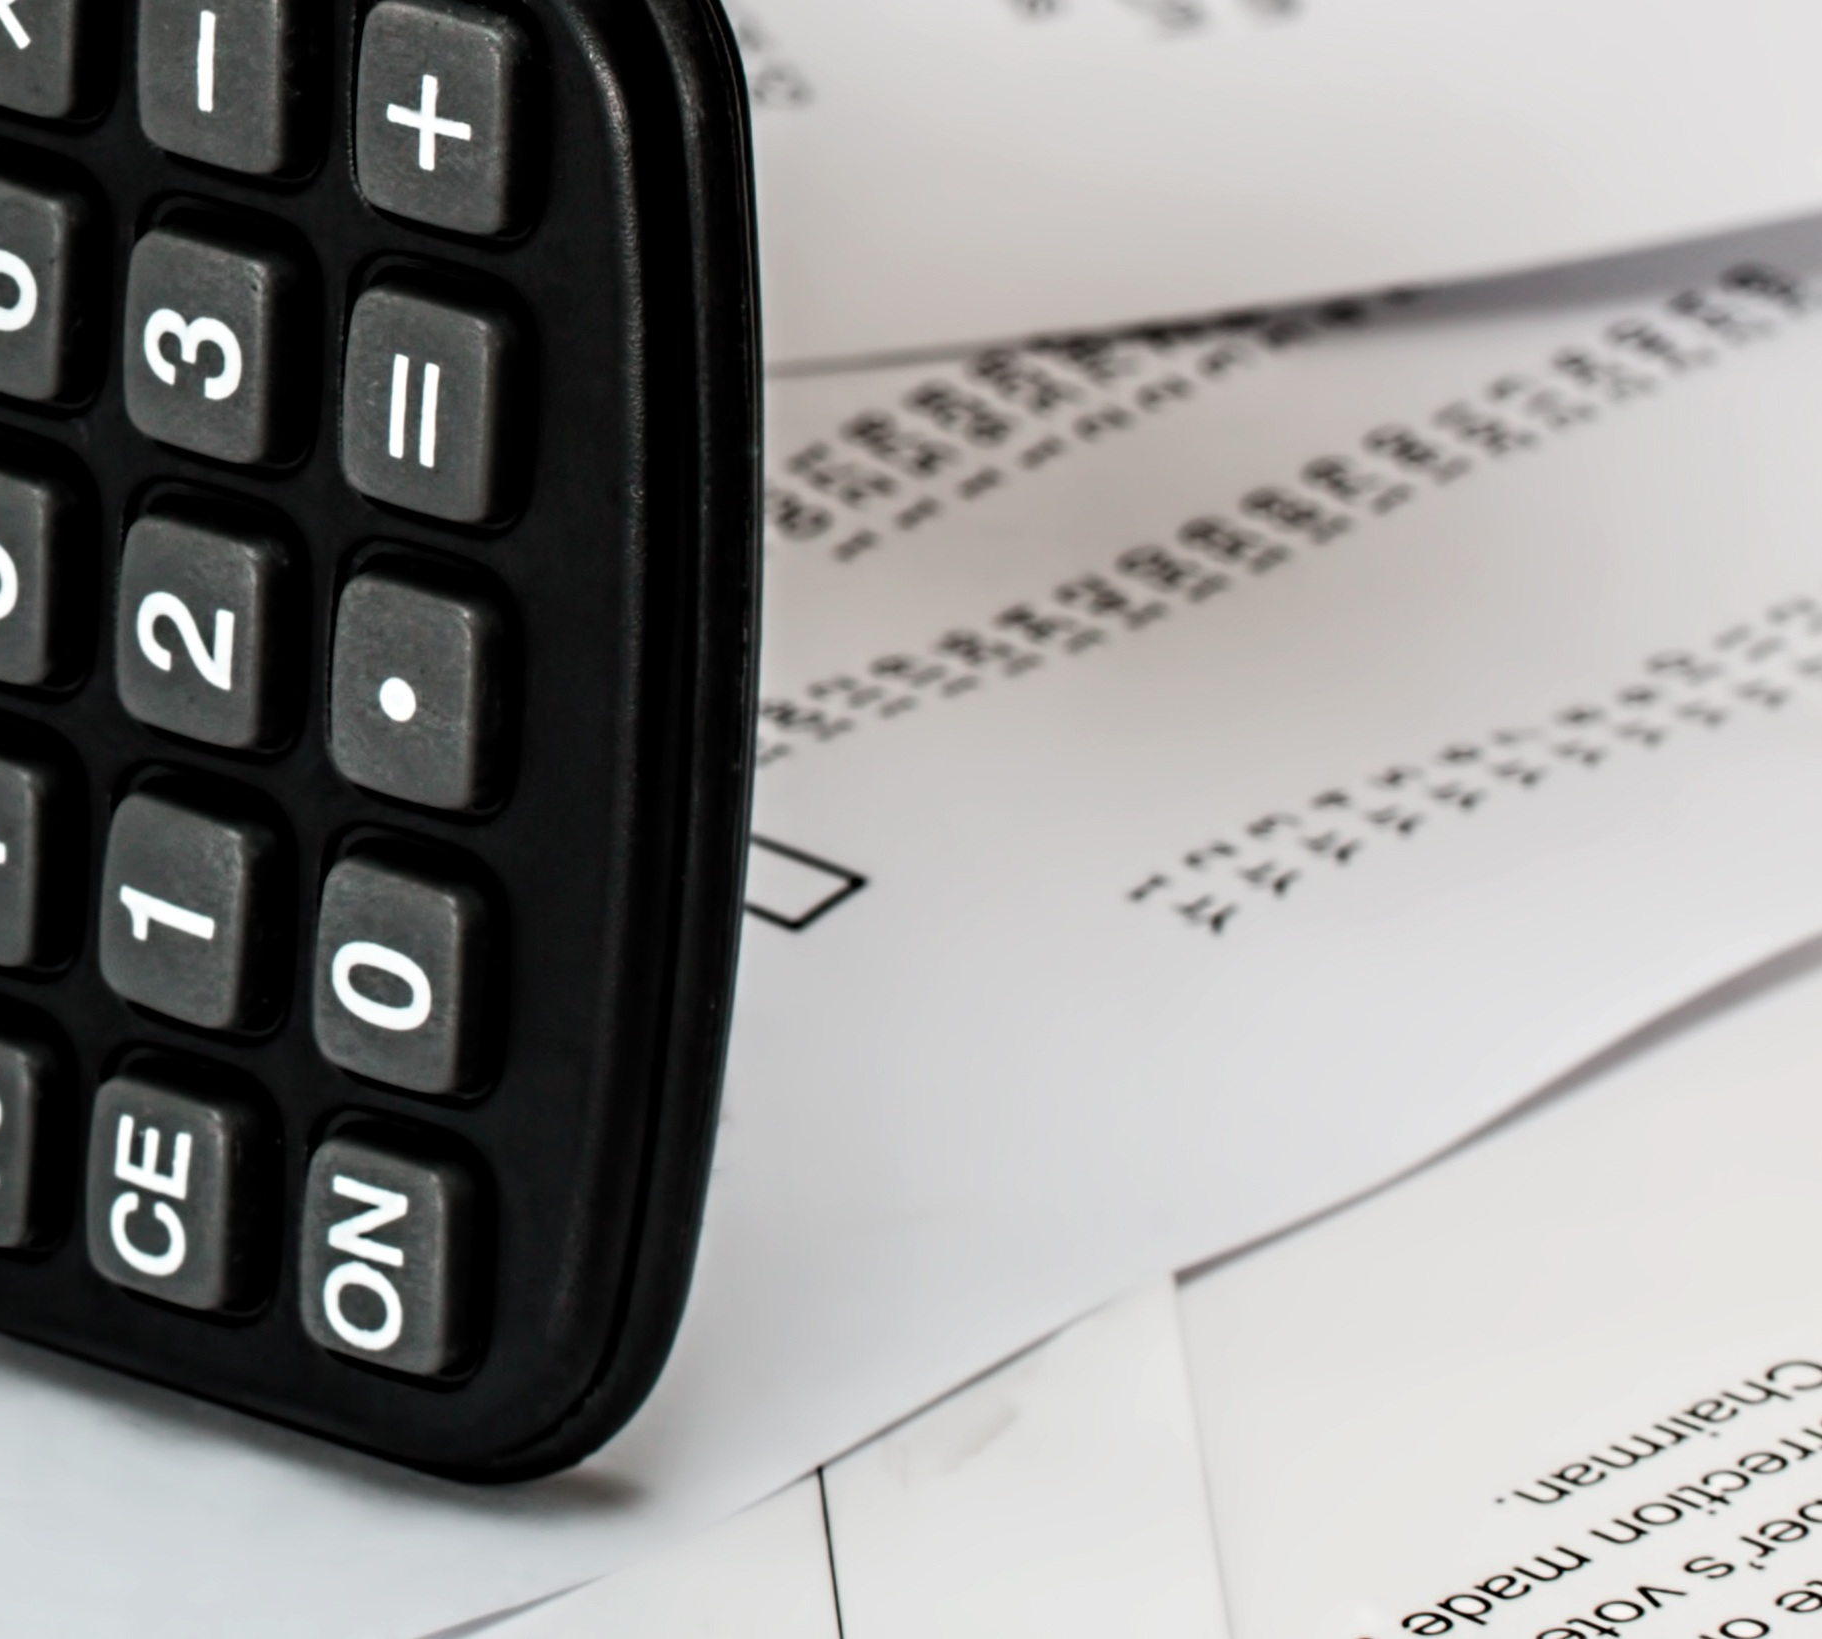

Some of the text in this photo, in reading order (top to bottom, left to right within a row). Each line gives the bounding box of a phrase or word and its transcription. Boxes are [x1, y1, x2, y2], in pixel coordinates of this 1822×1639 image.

[144, 309, 242, 400] 3
[137, 592, 234, 690] 2
[120, 885, 215, 940] 1
[332, 942, 431, 1030] 0
[111, 1115, 192, 1275] CE
[324, 1175, 408, 1350] ON
[1493, 1358, 1822, 1506] Chairman.
[1400, 1426, 1822, 1637] rrection made
